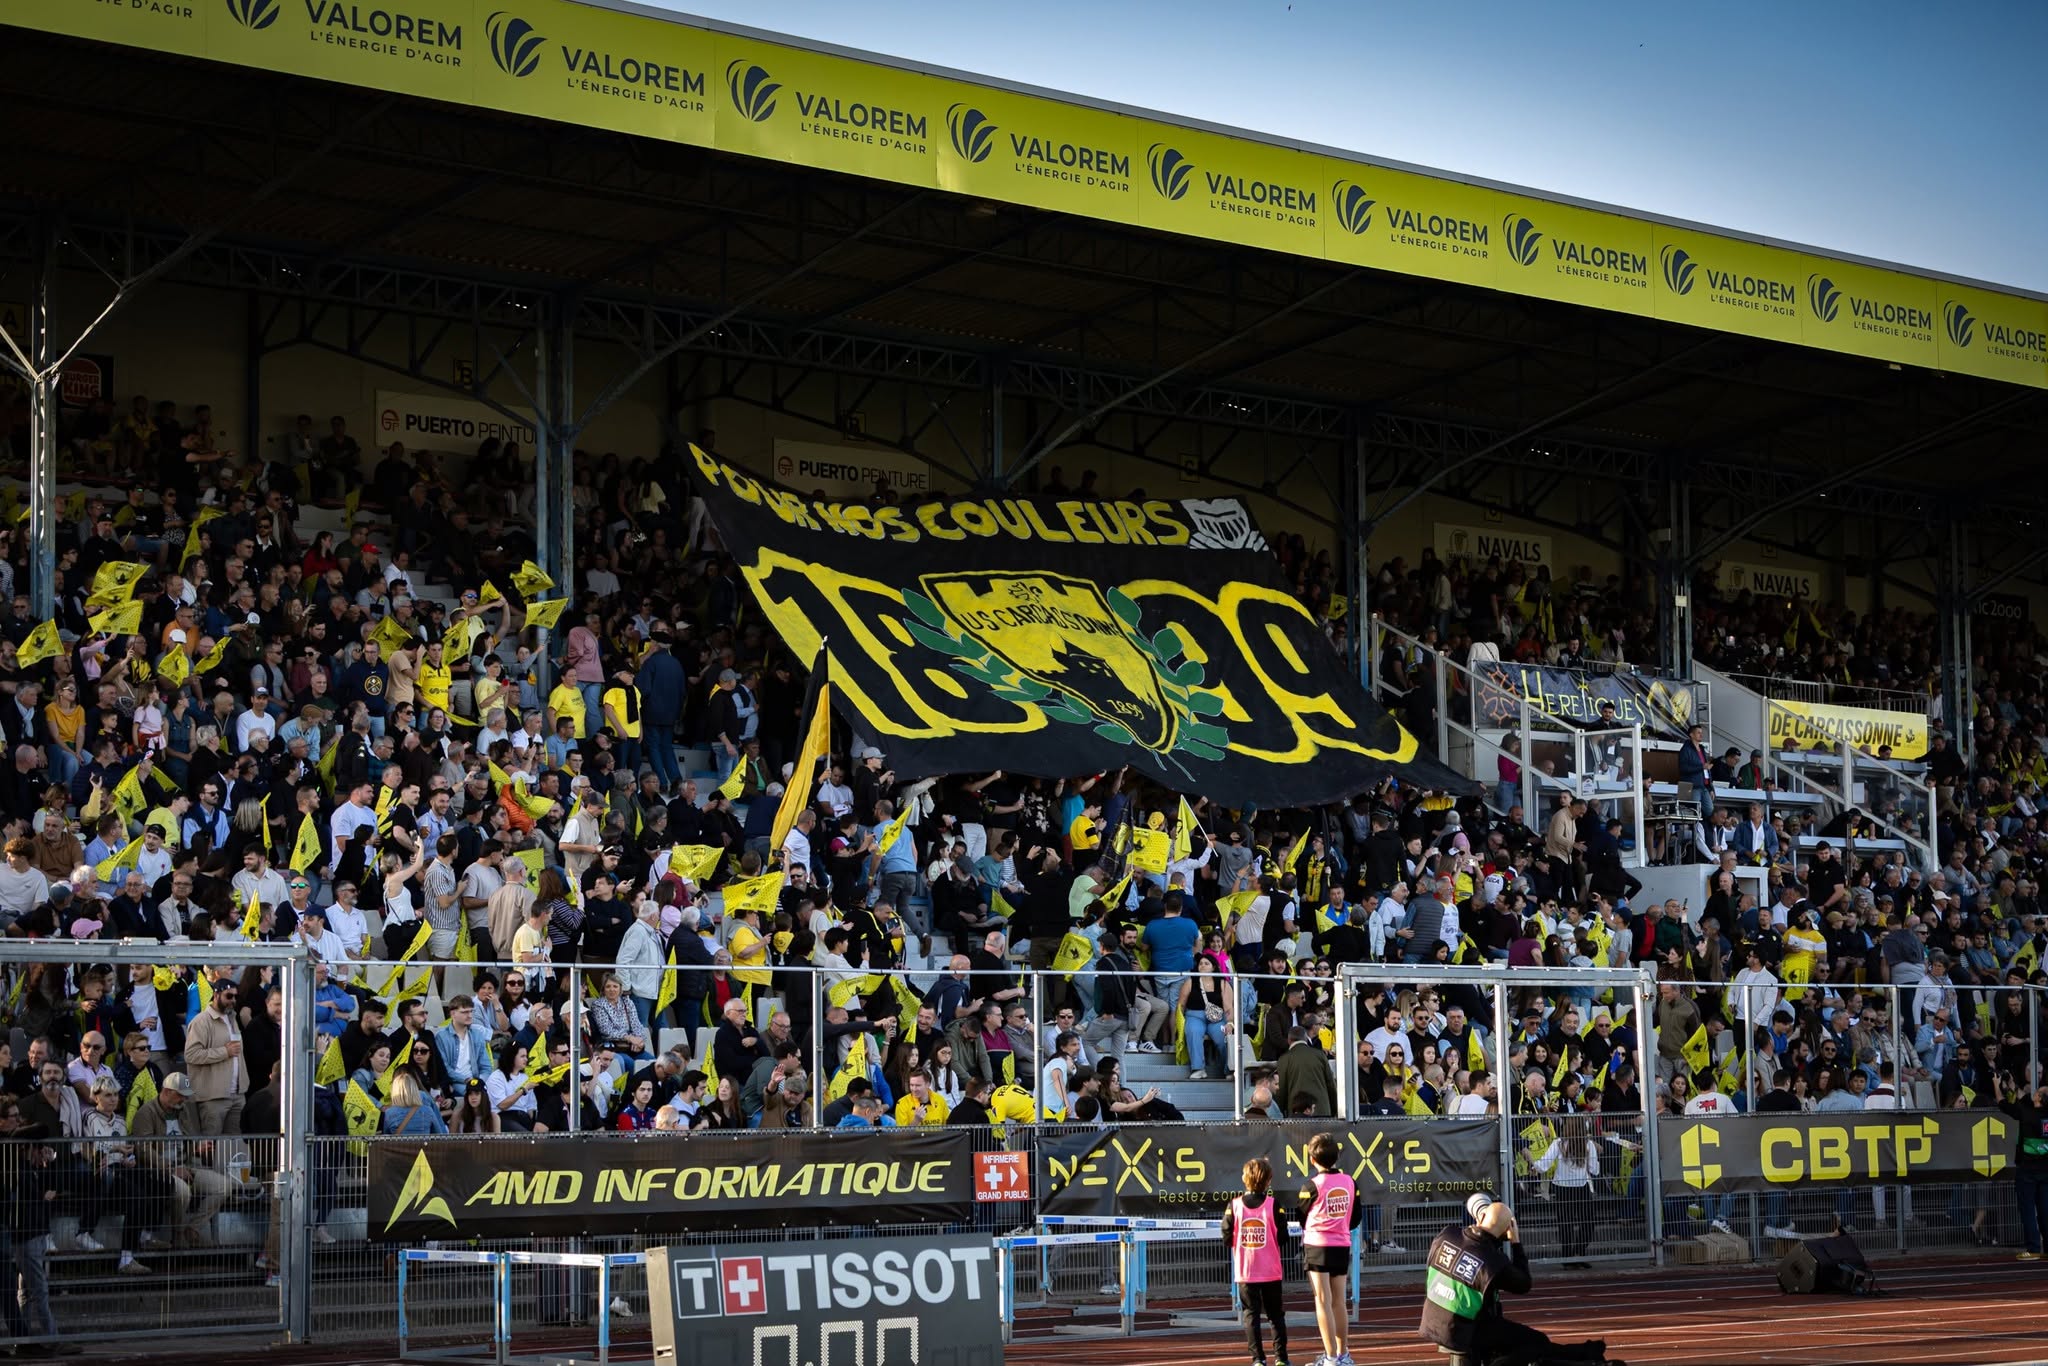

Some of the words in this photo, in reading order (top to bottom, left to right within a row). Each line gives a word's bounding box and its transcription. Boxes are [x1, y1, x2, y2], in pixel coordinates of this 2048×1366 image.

[305, 0, 462, 50] VALOREM
[310, 31, 397, 55] L'ÉNERGIE
[406, 48, 461, 67] D'AGIR
[561, 45, 705, 96] VALOREM
[567, 78, 646, 101] L'ÉNERGIE
[654, 94, 704, 112] D'AGIR
[795, 91, 927, 139] VALOREM
[801, 122, 873, 144] L'ÉNERGIE
[880, 137, 926, 154] D'AGIR
[1010, 133, 1129, 177] VALOREM
[1015, 163, 1080, 183] L'ÉNERGIE
[1087, 176, 1129, 192] D'AGIR
[1205, 171, 1316, 213] VALOREM
[1210, 200, 1271, 219] L'ÉNERGIE
[1277, 212, 1316, 227] D'AGIR
[1386, 206, 1488, 245] VALOREM
[1452, 245, 1488, 259] D'AGIR
[1552, 239, 1647, 275] VALOREM
[1707, 269, 1795, 304] VALOREM
[1850, 297, 1932, 330] VALOREM
[64, 384, 99, 396] KING
[406, 414, 475, 437] PUERTO
[478, 422, 537, 444] PEINTU
[800, 460, 858, 482] PUERTO
[862, 467, 928, 490] PEINTURE
[688, 442, 821, 530] POUR
[812, 500, 920, 543] NOS
[917, 498, 1190, 547] COULEURS
[1478, 536, 1541, 562] NAVALS
[960, 609, 1000, 632] US
[1106, 699, 1145, 721] 1899
[1771, 713, 1792, 737] DE
[1794, 714, 1903, 747] CARCASSONNE
[983, 1154, 1020, 1164] INFIRMERIE
[1760, 1116, 1940, 1183] CBTP
[464, 1170, 583, 1206] AMD
[593, 1160, 951, 1203] INFORMATIQUE
[977, 1191, 1002, 1200] GRAND
[1004, 1190, 1028, 1199] PUBLIC
[1159, 1188, 1206, 1203] Restez
[1389, 1179, 1432, 1193] Restez
[1437, 1176, 1494, 1192] connecté
[1171, 1231, 1197, 1239] DIMA
[1241, 1234, 1265, 1243] KING
[1462, 1255, 1479, 1267] PRO
[768, 1246, 991, 1312] TISSOT
